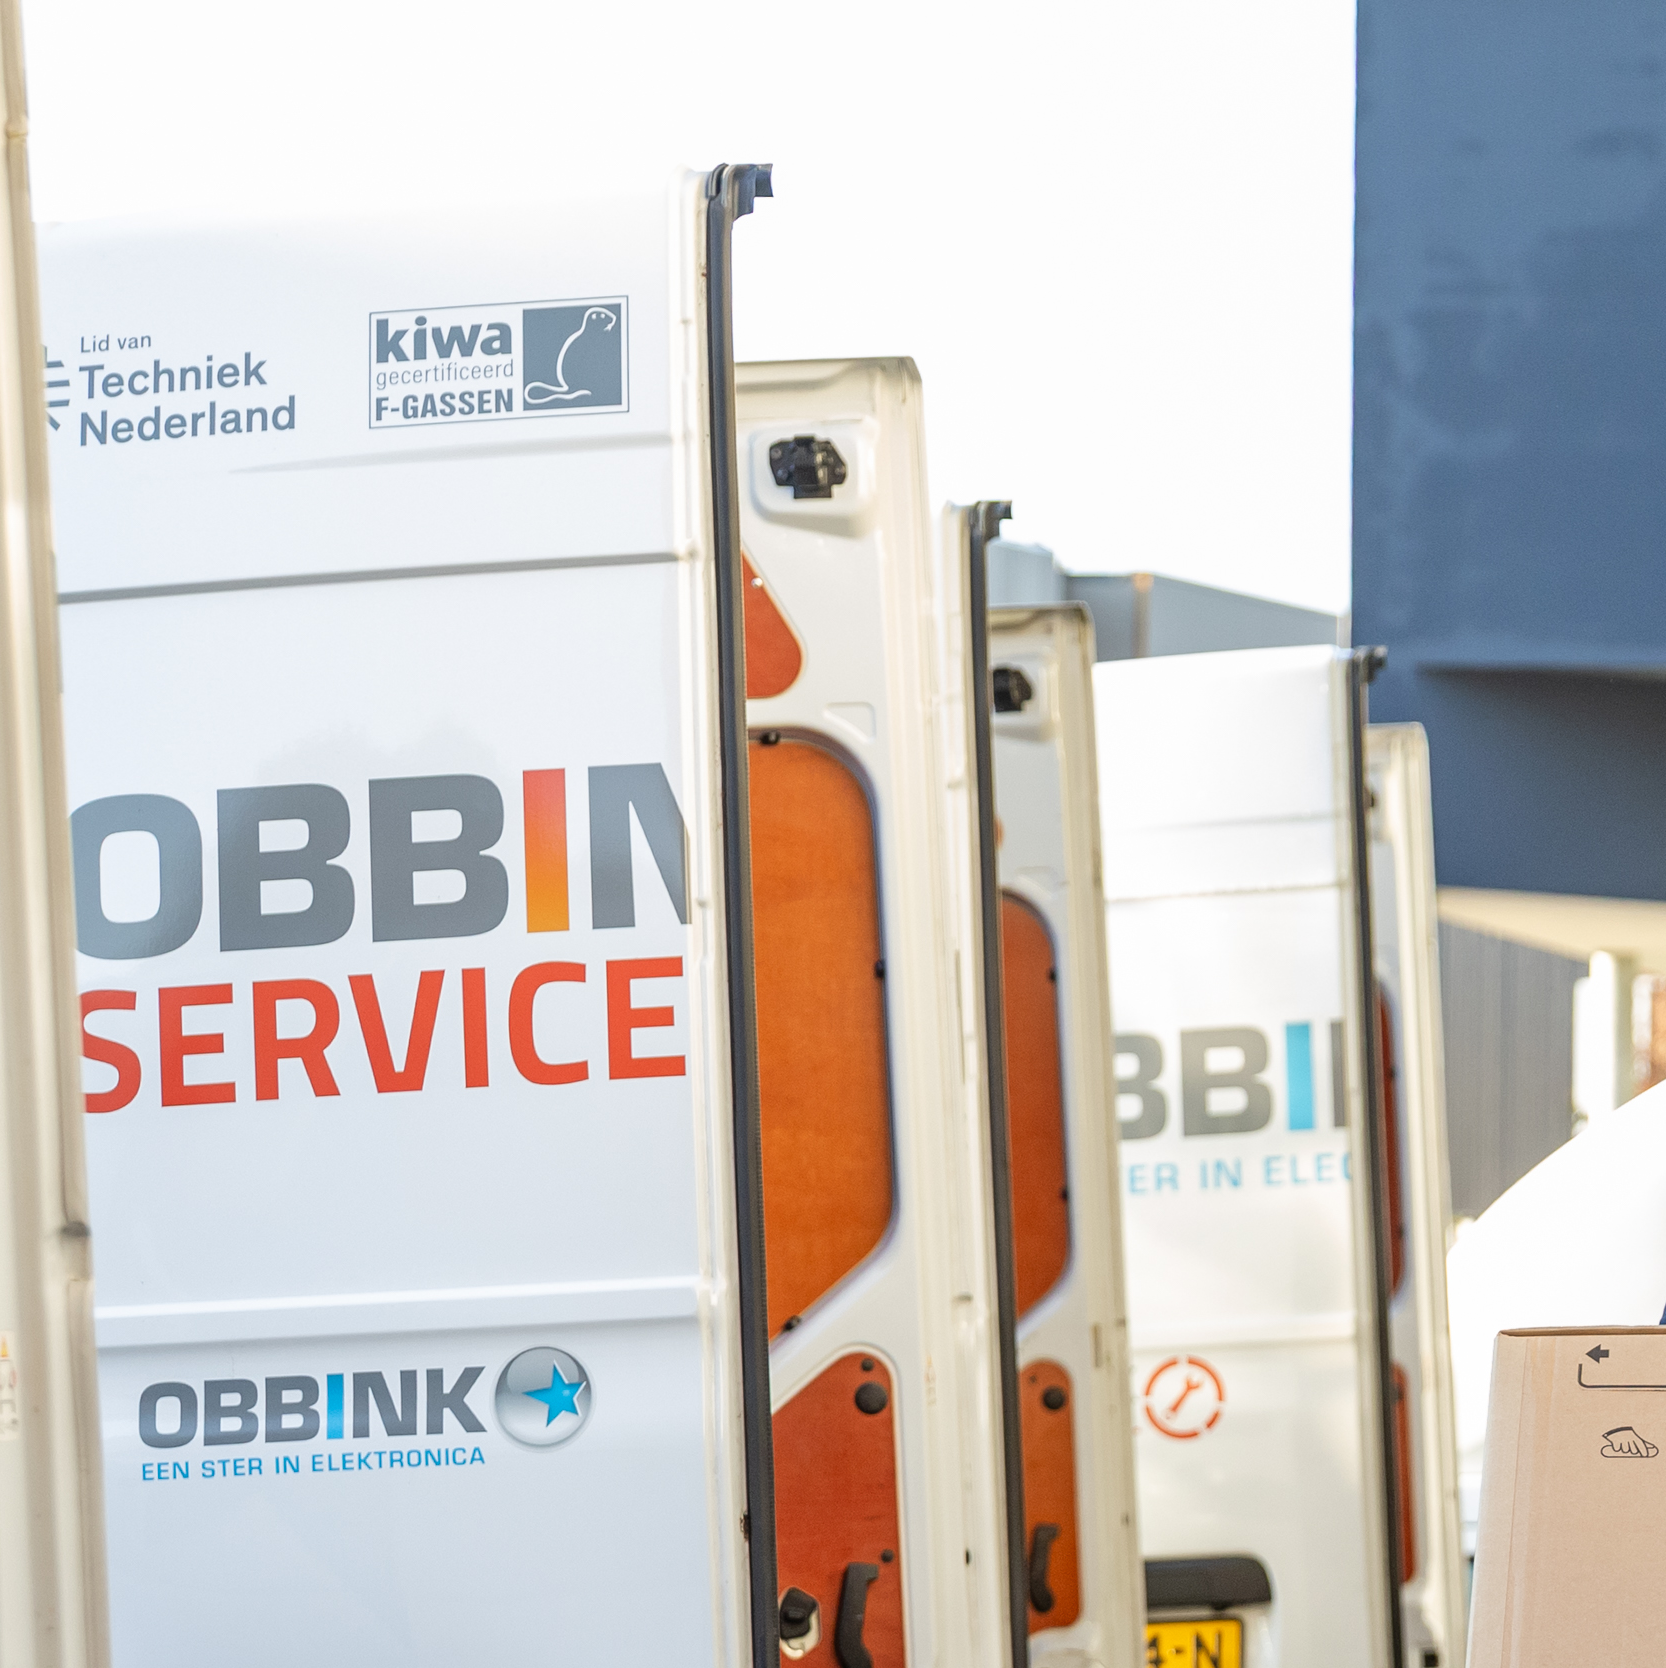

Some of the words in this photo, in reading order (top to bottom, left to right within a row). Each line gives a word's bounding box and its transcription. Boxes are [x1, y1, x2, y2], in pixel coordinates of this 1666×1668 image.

[80, 334, 110, 353] Lid
[117, 335, 152, 350] van
[376, 315, 512, 364] kiwa
[79, 351, 268, 399] Techniek
[376, 358, 514, 391] gecertificeerd
[80, 394, 296, 447] Nederland
[375, 388, 514, 422] F-GASSEN
[70, 762, 693, 960] OBBIN
[77, 955, 687, 1114] SERVICE
[1114, 1016, 1349, 1142] BBI
[1200, 1158, 1242, 1189] IN
[138, 1366, 488, 1448] OBBINK
[141, 1461, 190, 1481] EEN
[201, 1457, 263, 1479] STER
[275, 1455, 300, 1474] IN
[311, 1446, 486, 1472] ELEKTRONICA
